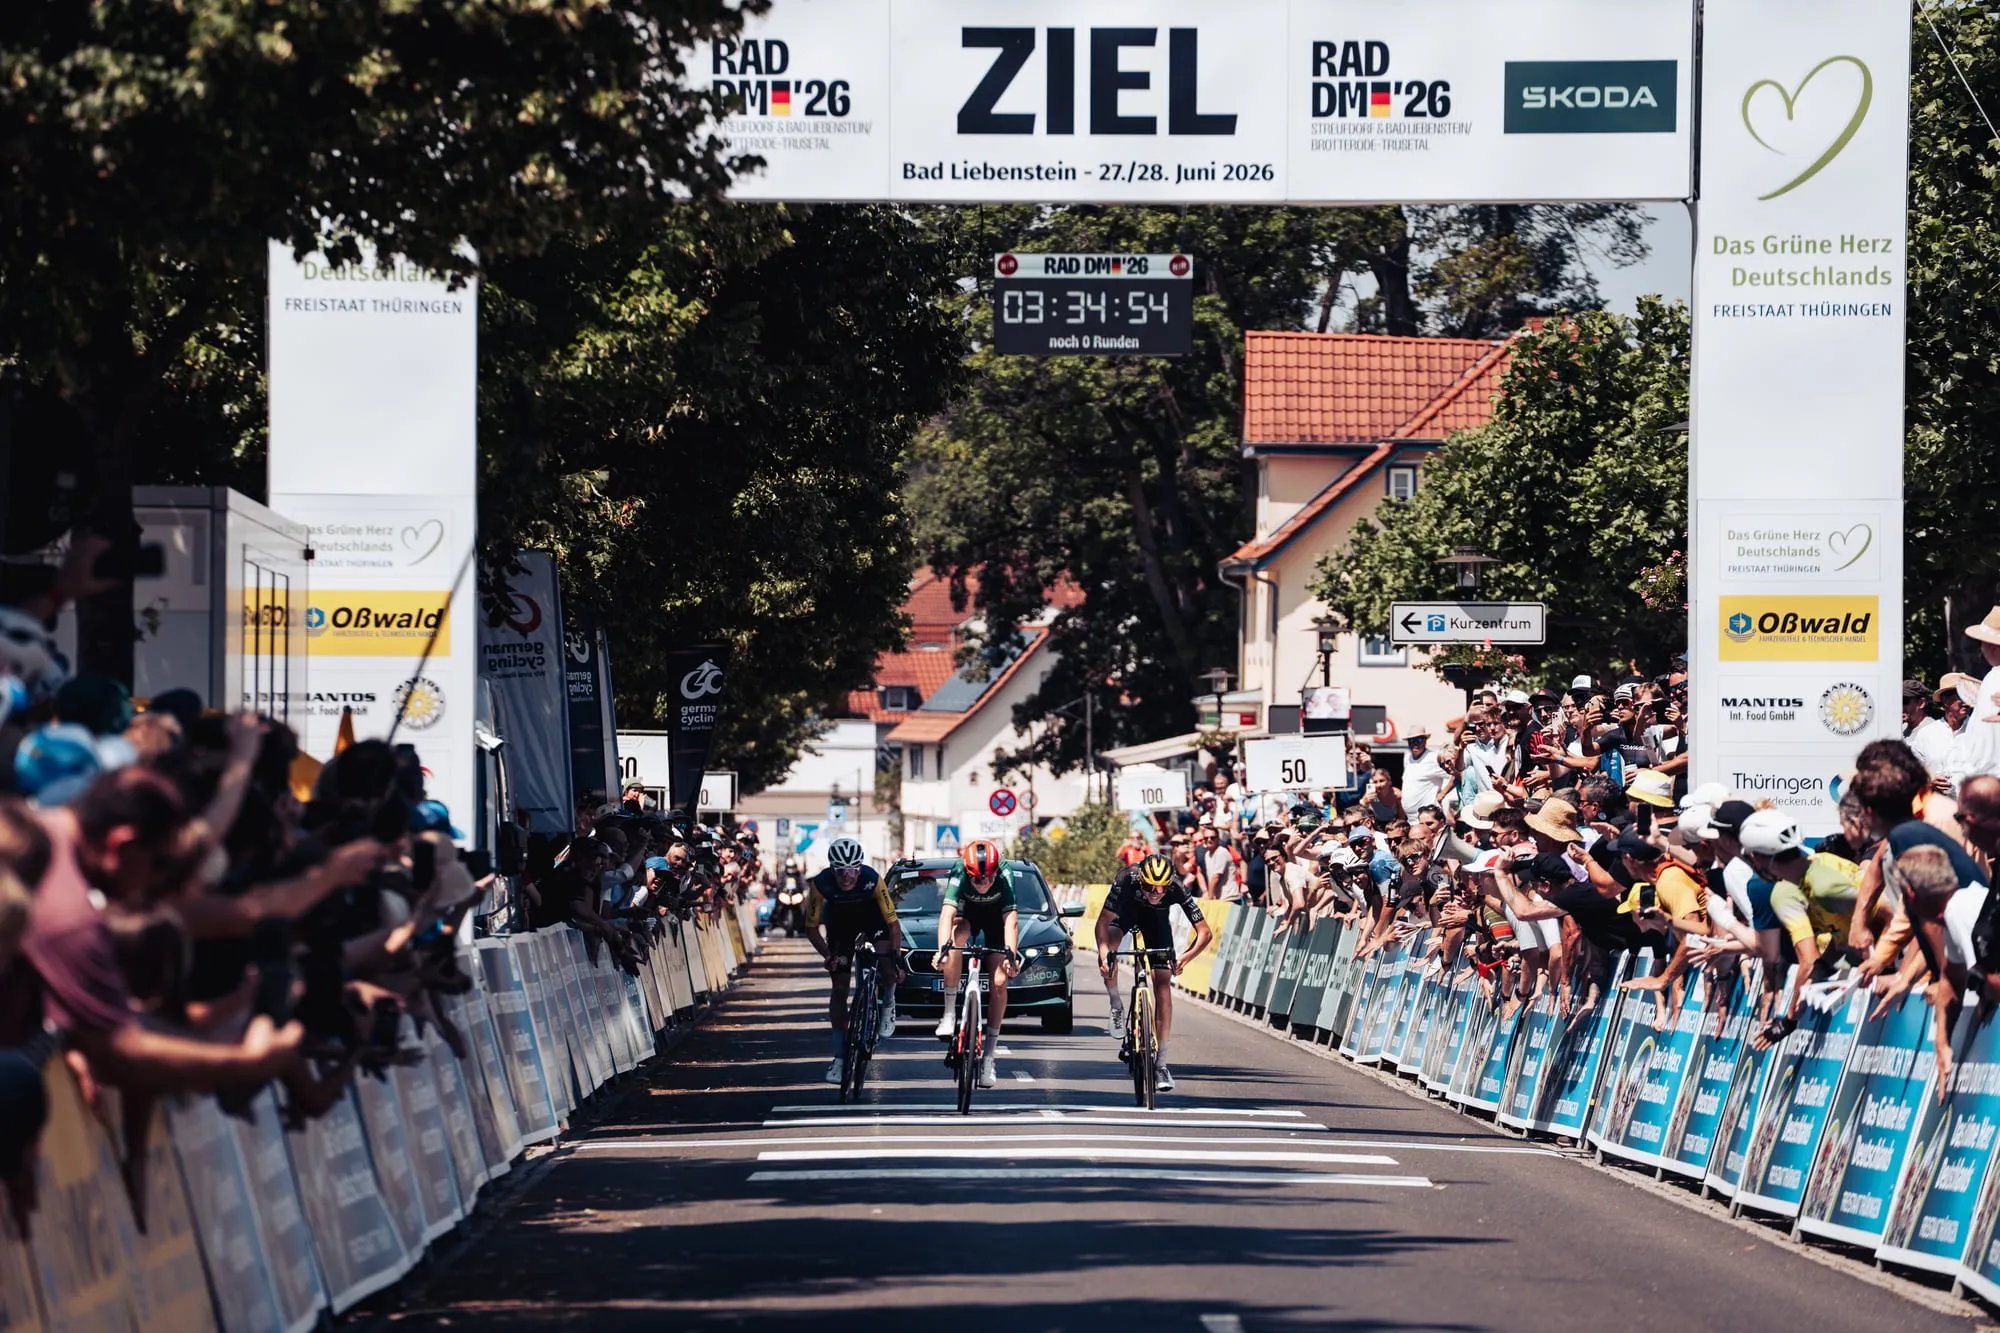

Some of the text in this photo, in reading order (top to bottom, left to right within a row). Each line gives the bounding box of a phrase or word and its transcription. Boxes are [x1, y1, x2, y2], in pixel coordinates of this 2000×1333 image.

[712, 39, 789, 75] RAD
[1312, 41, 1390, 77] RAD
[957, 26, 1238, 135] ZIEL
[1311, 123, 1373, 134] STREUFDORF
[1385, 123, 1406, 134] BAD
[903, 161, 944, 180] Bad
[951, 161, 1077, 181] Liebenstein
[1099, 161, 1169, 184] 27./28.
[1175, 161, 1216, 184] Juni
[1223, 163, 1274, 181] 2026
[1713, 234, 1893, 255] Das Grüne Herz
[1044, 257, 1081, 274] RAD
[1732, 265, 1893, 287] Deutschlands
[285, 298, 463, 314] FREISTAAT THÜRINGEN
[1003, 290, 1169, 325] 03:34:54
[1713, 302, 1891, 317] FREISTAAT THÜRINGEN
[1049, 334, 1140, 349] noch 0 Runden
[326, 523, 363, 536] Grüne
[365, 525, 393, 536] Herz
[1727, 529, 1821, 541] Das Grüne Herz
[1737, 546, 1821, 557] Deutschlands
[1728, 565, 1771, 573] FREISTAAT
[332, 607, 443, 629] Oßwald
[1450, 617, 1531, 630] Kurzentrum
[1758, 612, 1871, 634] Oßwald
[1822, 682, 1868, 699] MANTOS
[1721, 697, 1804, 708] MANTOS
[681, 713, 714, 726] cyclin
[1729, 710, 1795, 721] Int. Food GmbH
[1281, 758, 1306, 784] 50
[1732, 772, 1823, 795] Thüringen
[1141, 787, 1163, 805] 100
